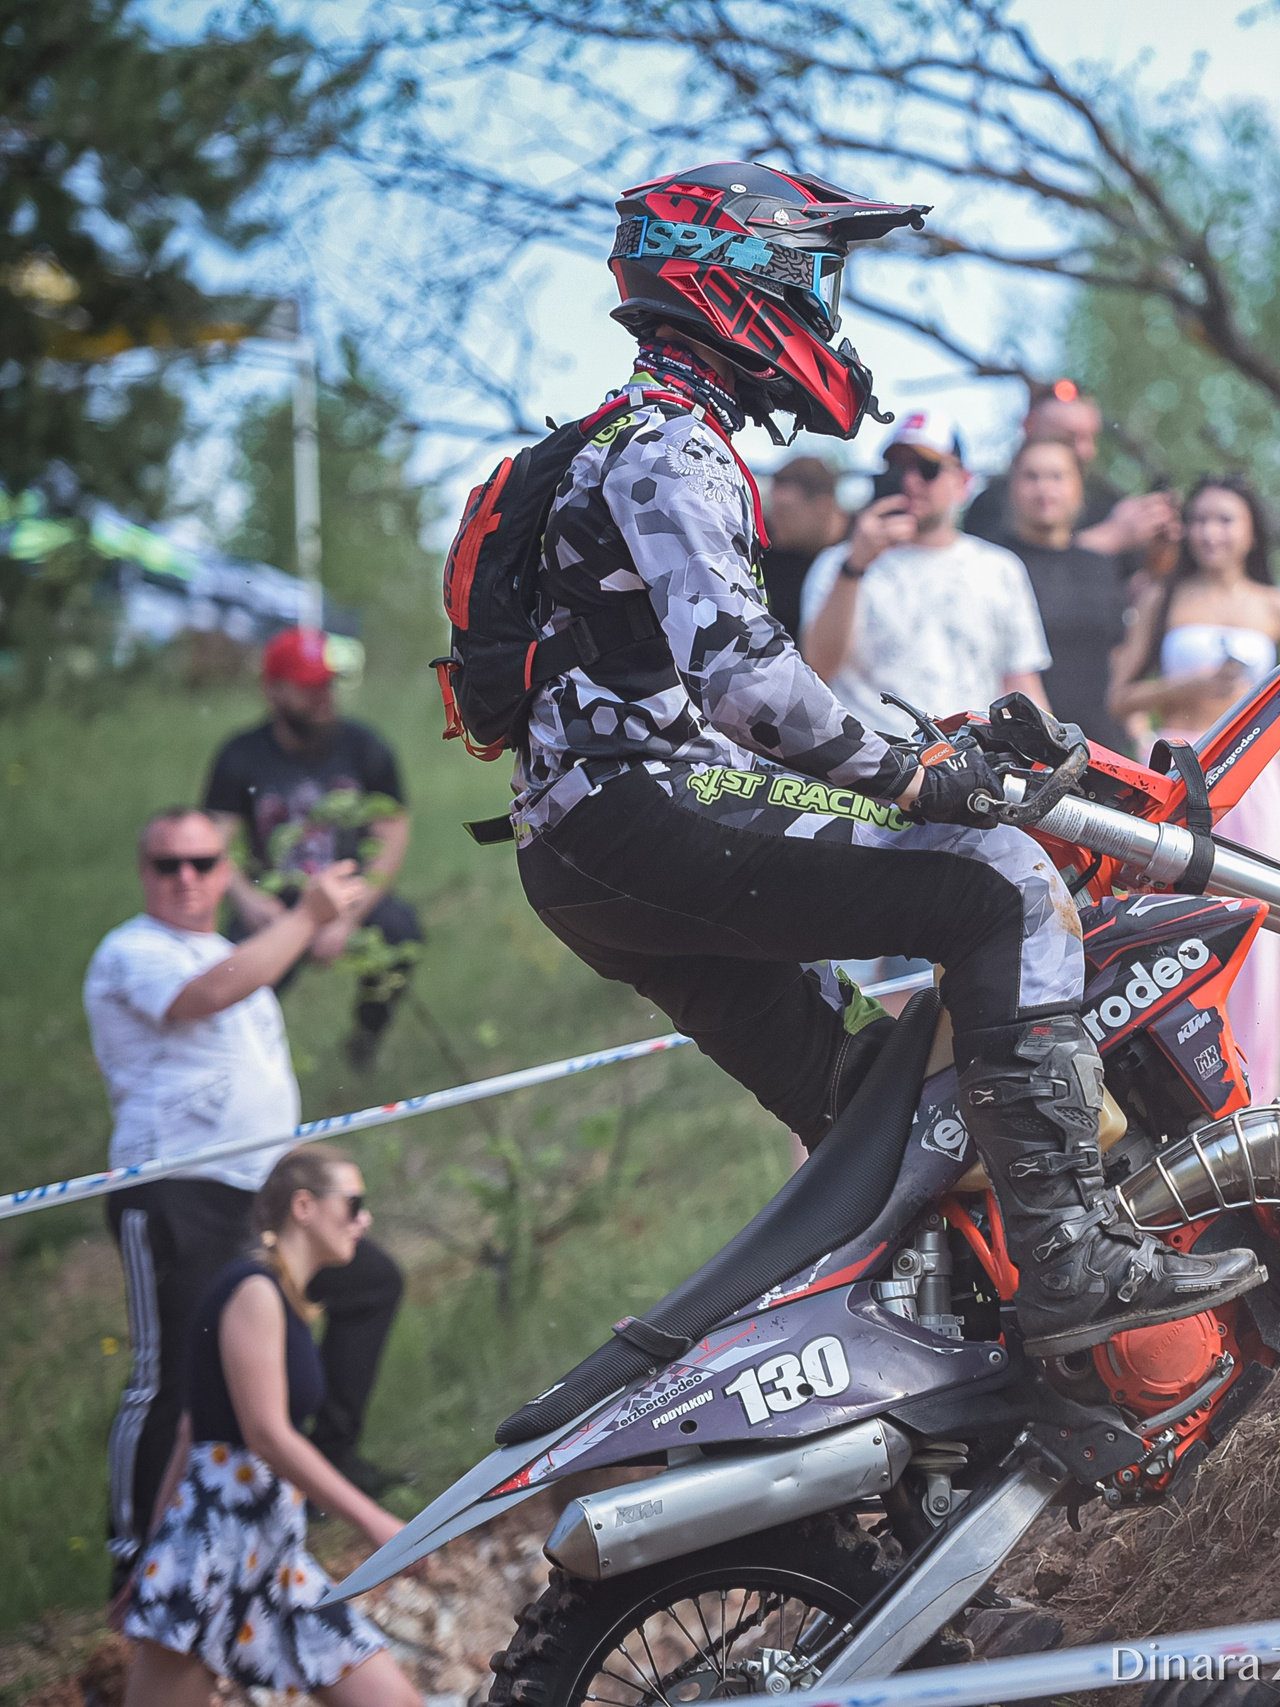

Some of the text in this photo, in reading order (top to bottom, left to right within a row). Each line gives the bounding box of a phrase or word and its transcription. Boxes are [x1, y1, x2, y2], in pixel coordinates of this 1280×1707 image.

[1081, 938, 1210, 1042] rodeo
[1176, 1010, 1212, 1045] KTM
[618, 1373, 704, 1428] erzbergrodeo
[724, 1335, 852, 1428] 130
[651, 1388, 715, 1430] PODYAKOV
[614, 1499, 664, 1528] KTM
